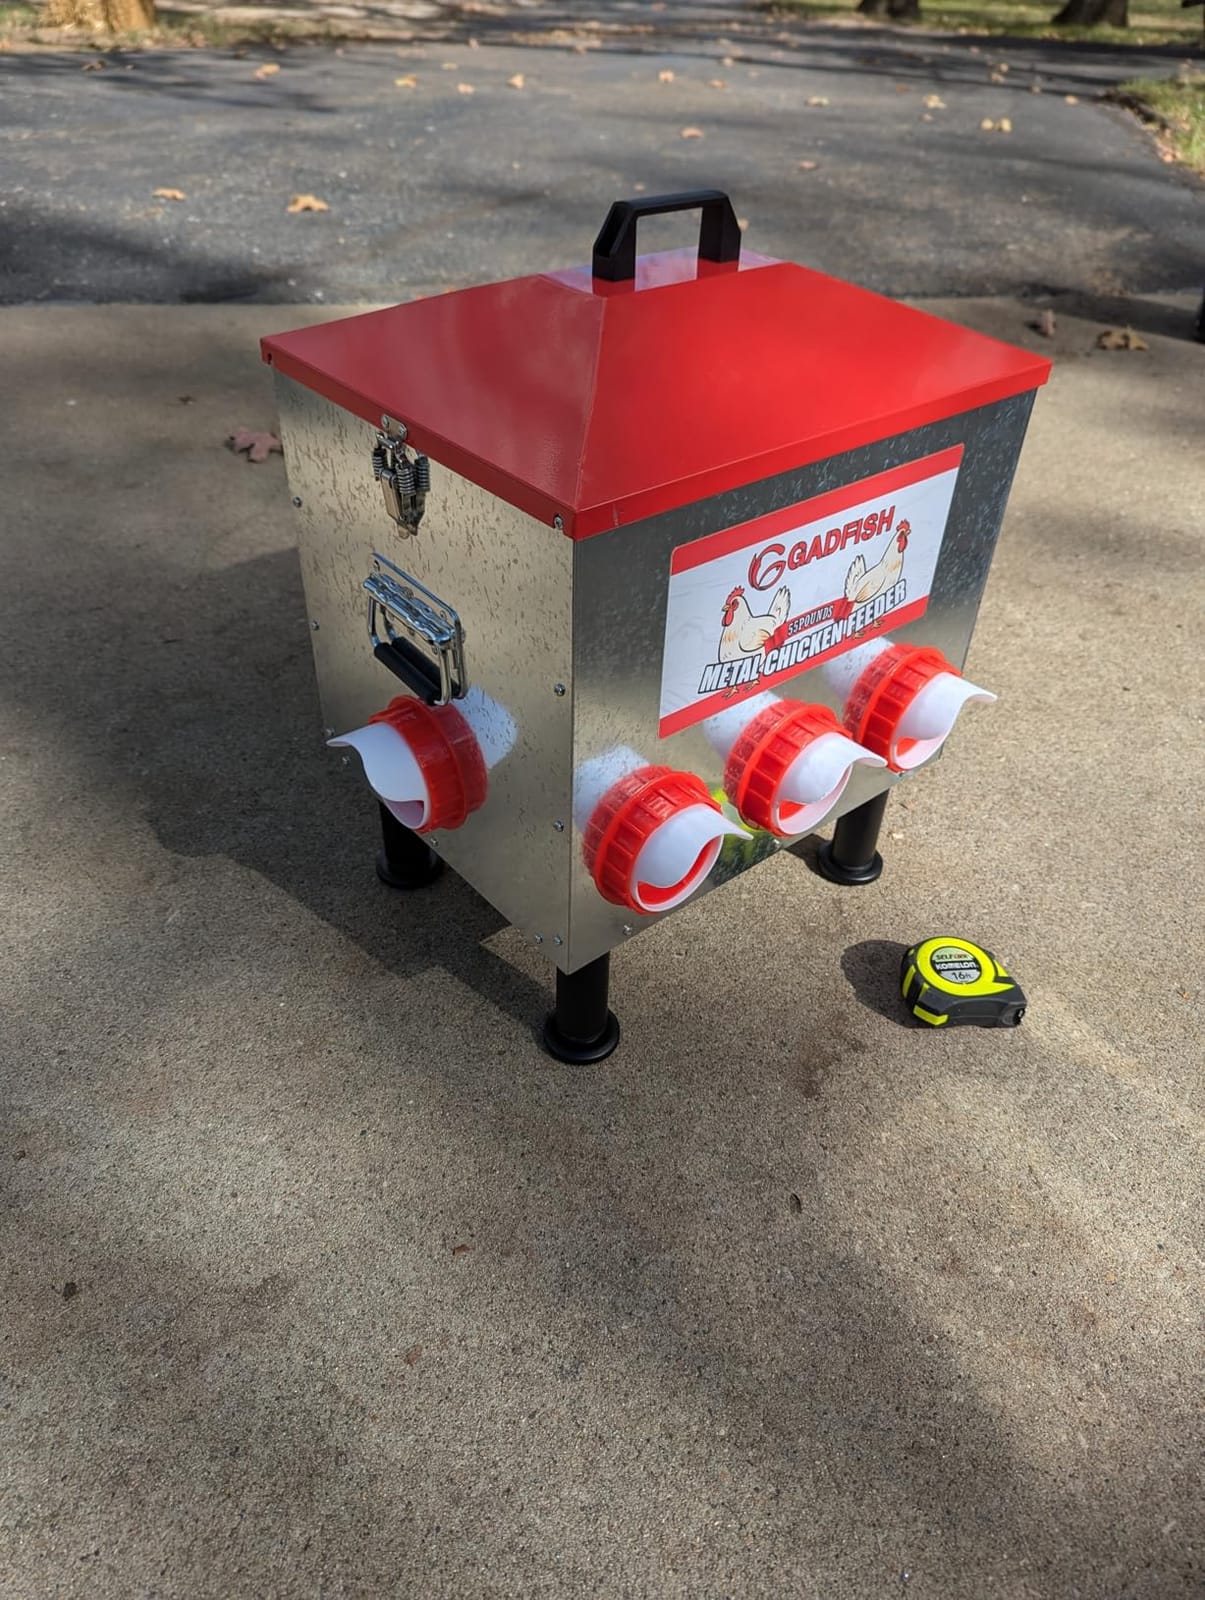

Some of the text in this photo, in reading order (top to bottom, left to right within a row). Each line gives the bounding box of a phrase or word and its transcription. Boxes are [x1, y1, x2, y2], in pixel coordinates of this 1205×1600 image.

[788, 506, 895, 570] GADFISH
[698, 579, 907, 694] METAL CHICKEN FEEDER
